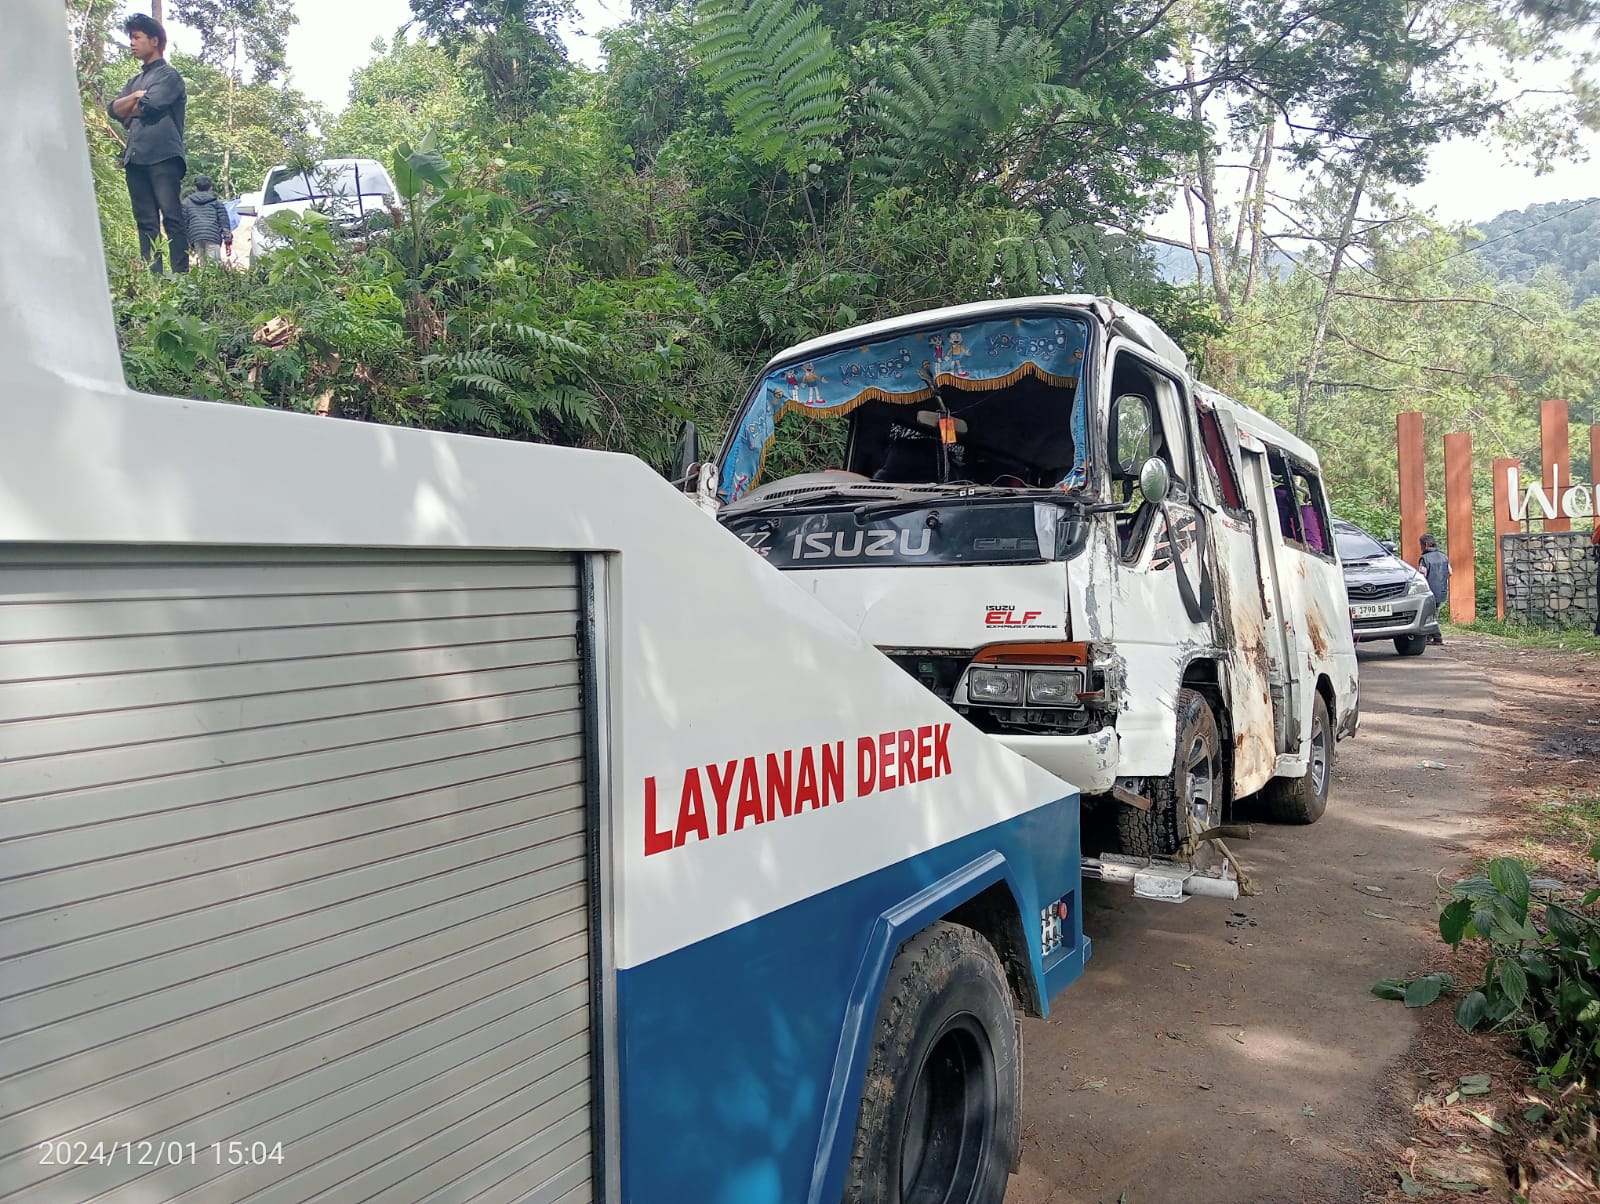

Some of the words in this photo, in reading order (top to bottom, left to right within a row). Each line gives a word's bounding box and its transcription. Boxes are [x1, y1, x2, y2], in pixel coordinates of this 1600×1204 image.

[1507, 463, 1600, 521] Wo
[792, 528, 931, 559] ISUZU
[985, 611, 1042, 624] ELF
[644, 740, 844, 857] LAYANAN
[857, 723, 952, 797] DEREK
